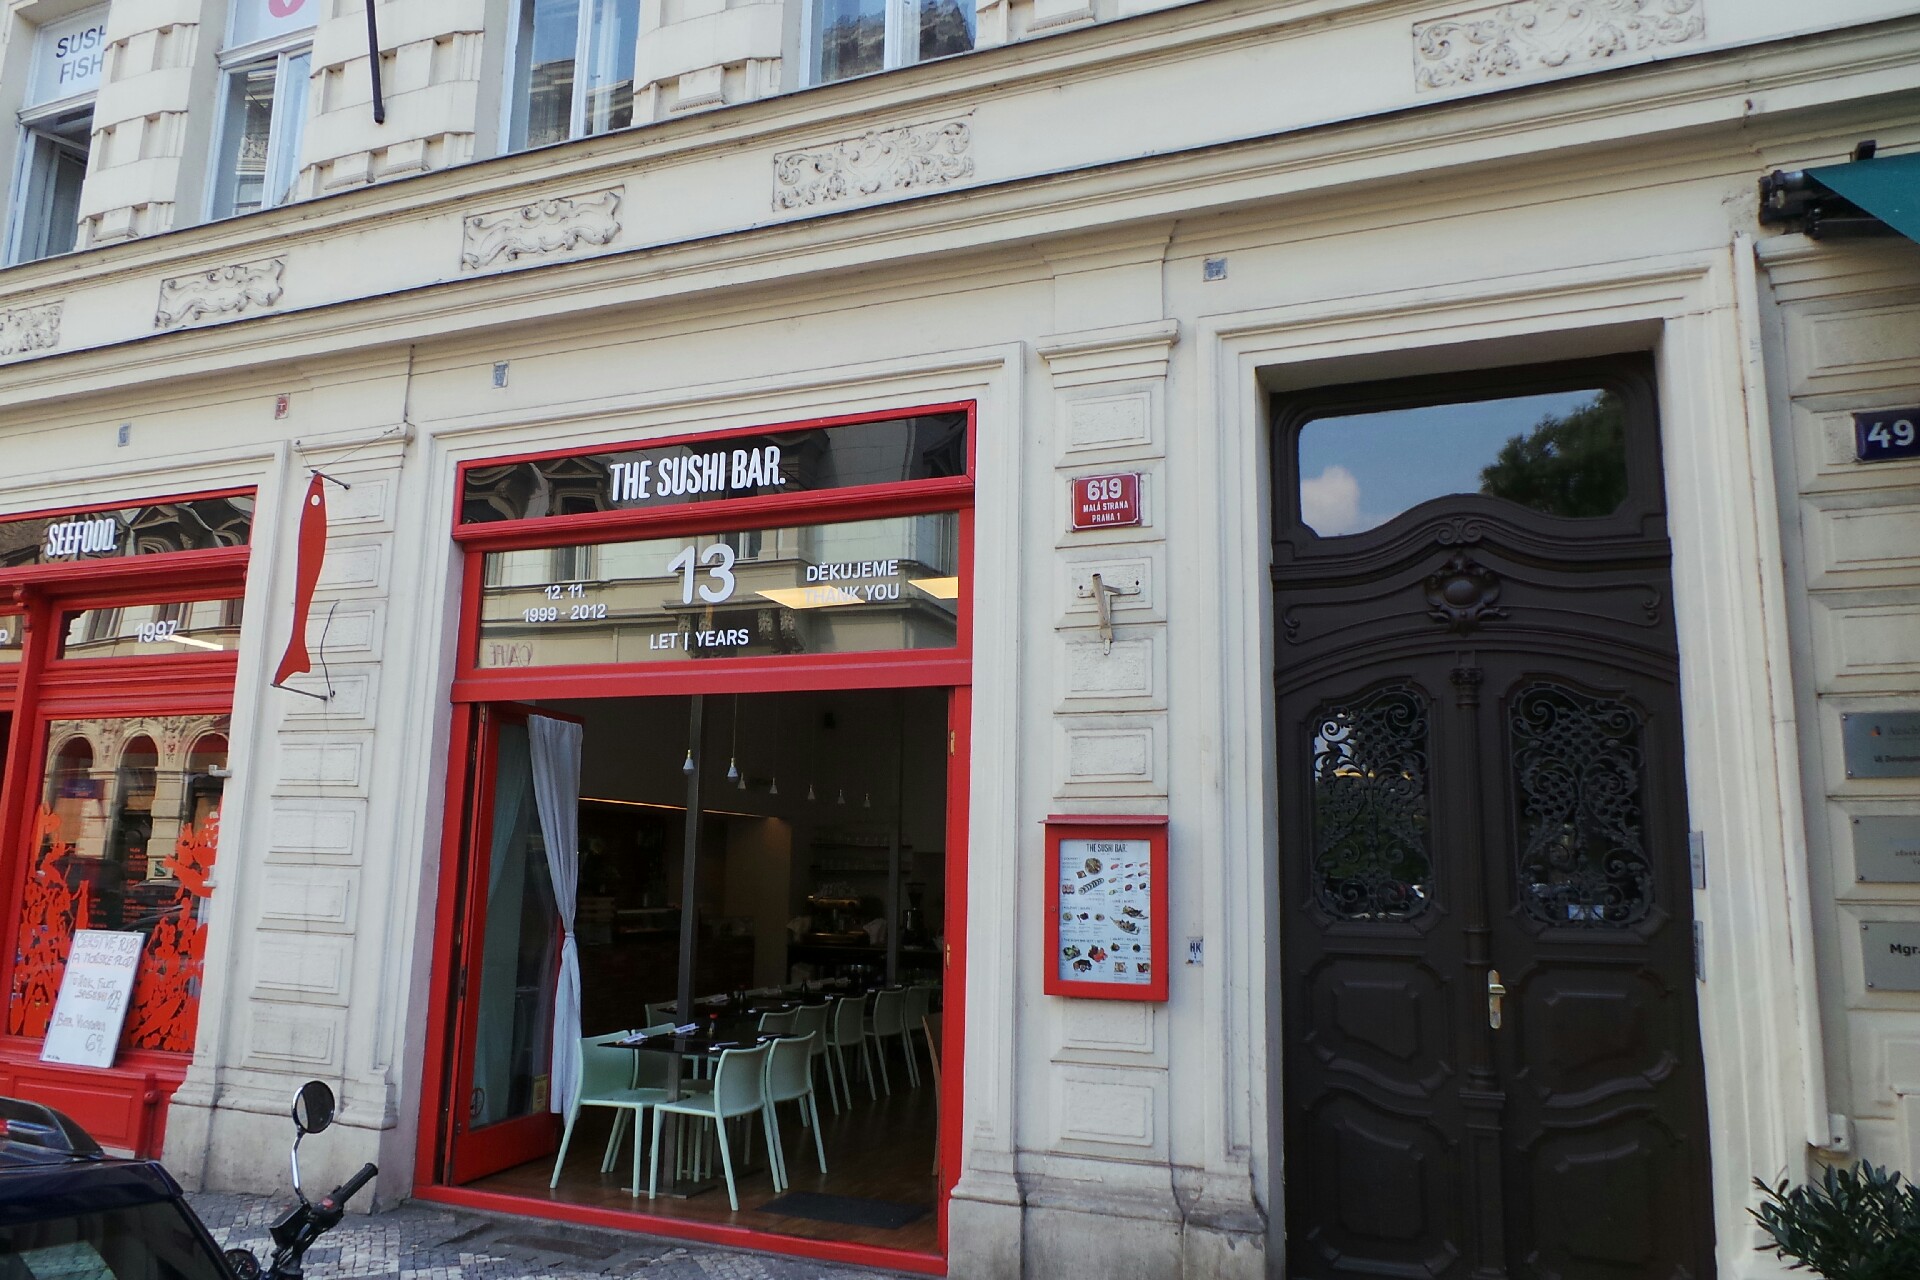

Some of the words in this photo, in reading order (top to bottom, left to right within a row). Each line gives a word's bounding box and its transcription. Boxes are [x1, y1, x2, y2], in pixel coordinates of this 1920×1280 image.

[60, 52, 104, 84] FISH
[1867, 419, 1915, 448] 49
[610, 460, 652, 501] THE
[657, 451, 726, 497] SUSHI
[731, 446, 786, 489] BAR.
[1087, 478, 1122, 500] 619
[1083, 501, 1101, 513] MALÁ
[1102, 501, 1128, 511] STRANA
[1092, 513, 1115, 523] PRAHA
[1116, 512, 1120, 520] 1
[667, 543, 735, 605] 13
[806, 559, 899, 582] DĚKUJEME
[544, 585, 564, 600] 12.
[567, 583, 586, 599] 11.
[804, 586, 860, 605] THANK
[865, 583, 900, 601] YOU
[522, 606, 557, 623] 1999
[570, 603, 607, 620] 2012
[135, 620, 177, 643] 1997
[650, 632, 679, 651] LET
[696, 628, 750, 648] YEARS
[1086, 843, 1097, 853] THE
[1097, 843, 1114, 853] SUSHI
[1889, 943, 1920, 957] Mgr.
